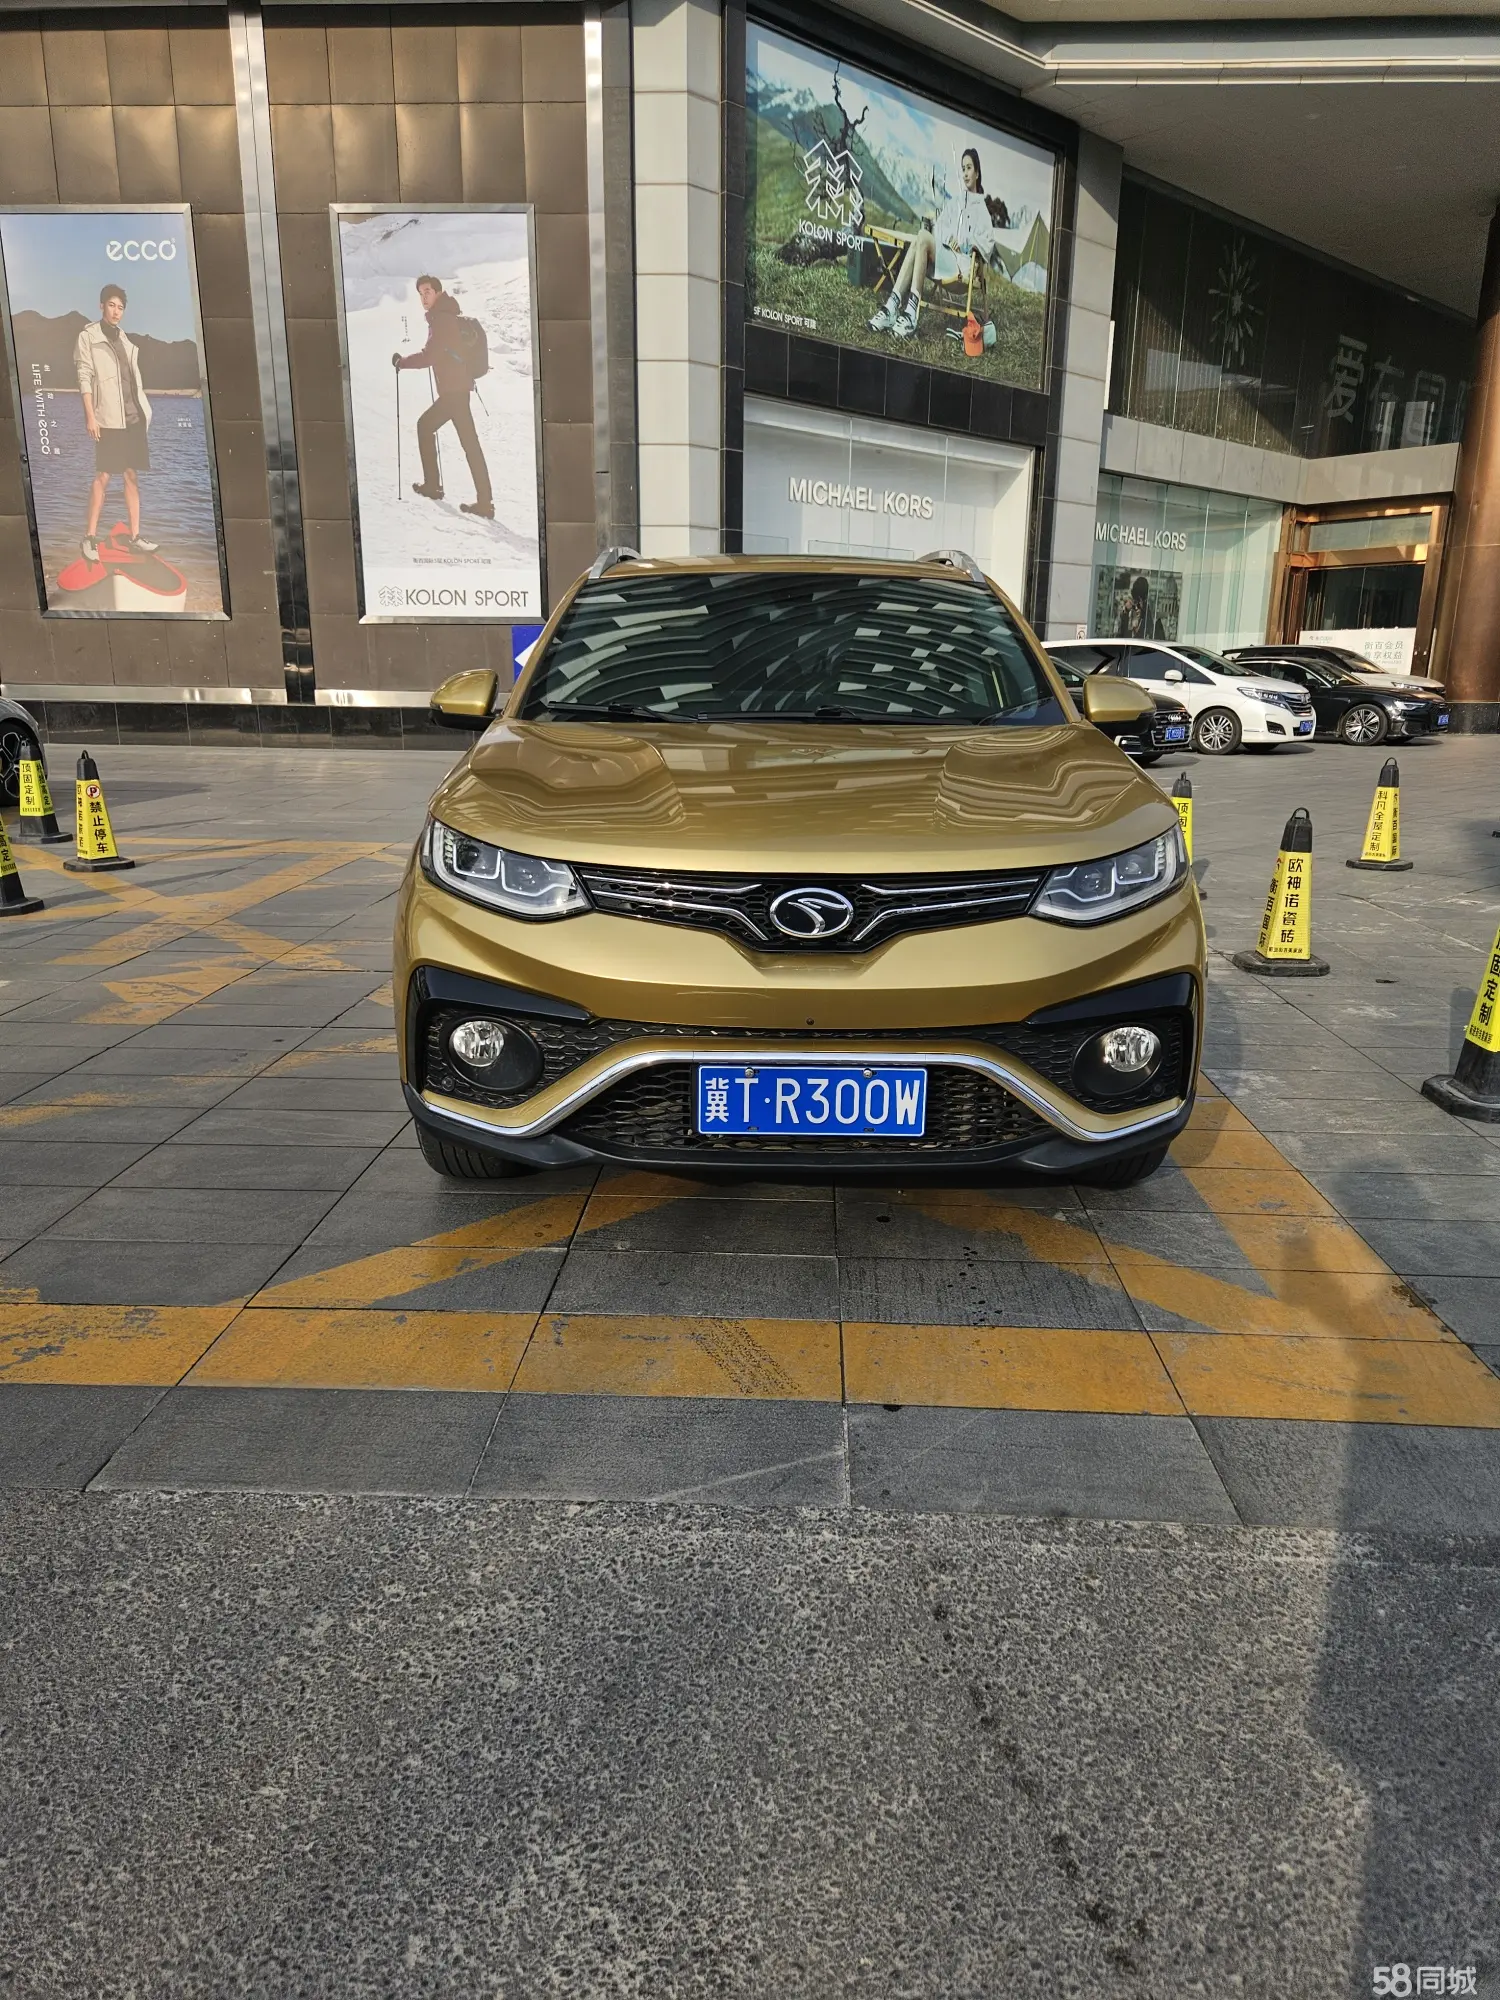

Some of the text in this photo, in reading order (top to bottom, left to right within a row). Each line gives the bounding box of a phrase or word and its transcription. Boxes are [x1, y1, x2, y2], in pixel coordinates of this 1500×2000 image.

[106, 239, 177, 261] ecco
[799, 218, 864, 252] KOLON SPORT
[761, 308, 783, 322] KOLON
[784, 313, 803, 326] SPORT
[32, 363, 52, 455] LIFE WITH ecco
[789, 476, 934, 519] MICHAEL KORS
[1095, 521, 1187, 551] MICHAEL KORS
[405, 588, 529, 608] KOLON SPORT
[21, 763, 36, 806] 顶固定制
[89, 801, 110, 854] 禁止停车
[1369, 790, 1388, 852] 科凡全屋定制
[1280, 858, 1304, 943] 欧神诺瓷砖
